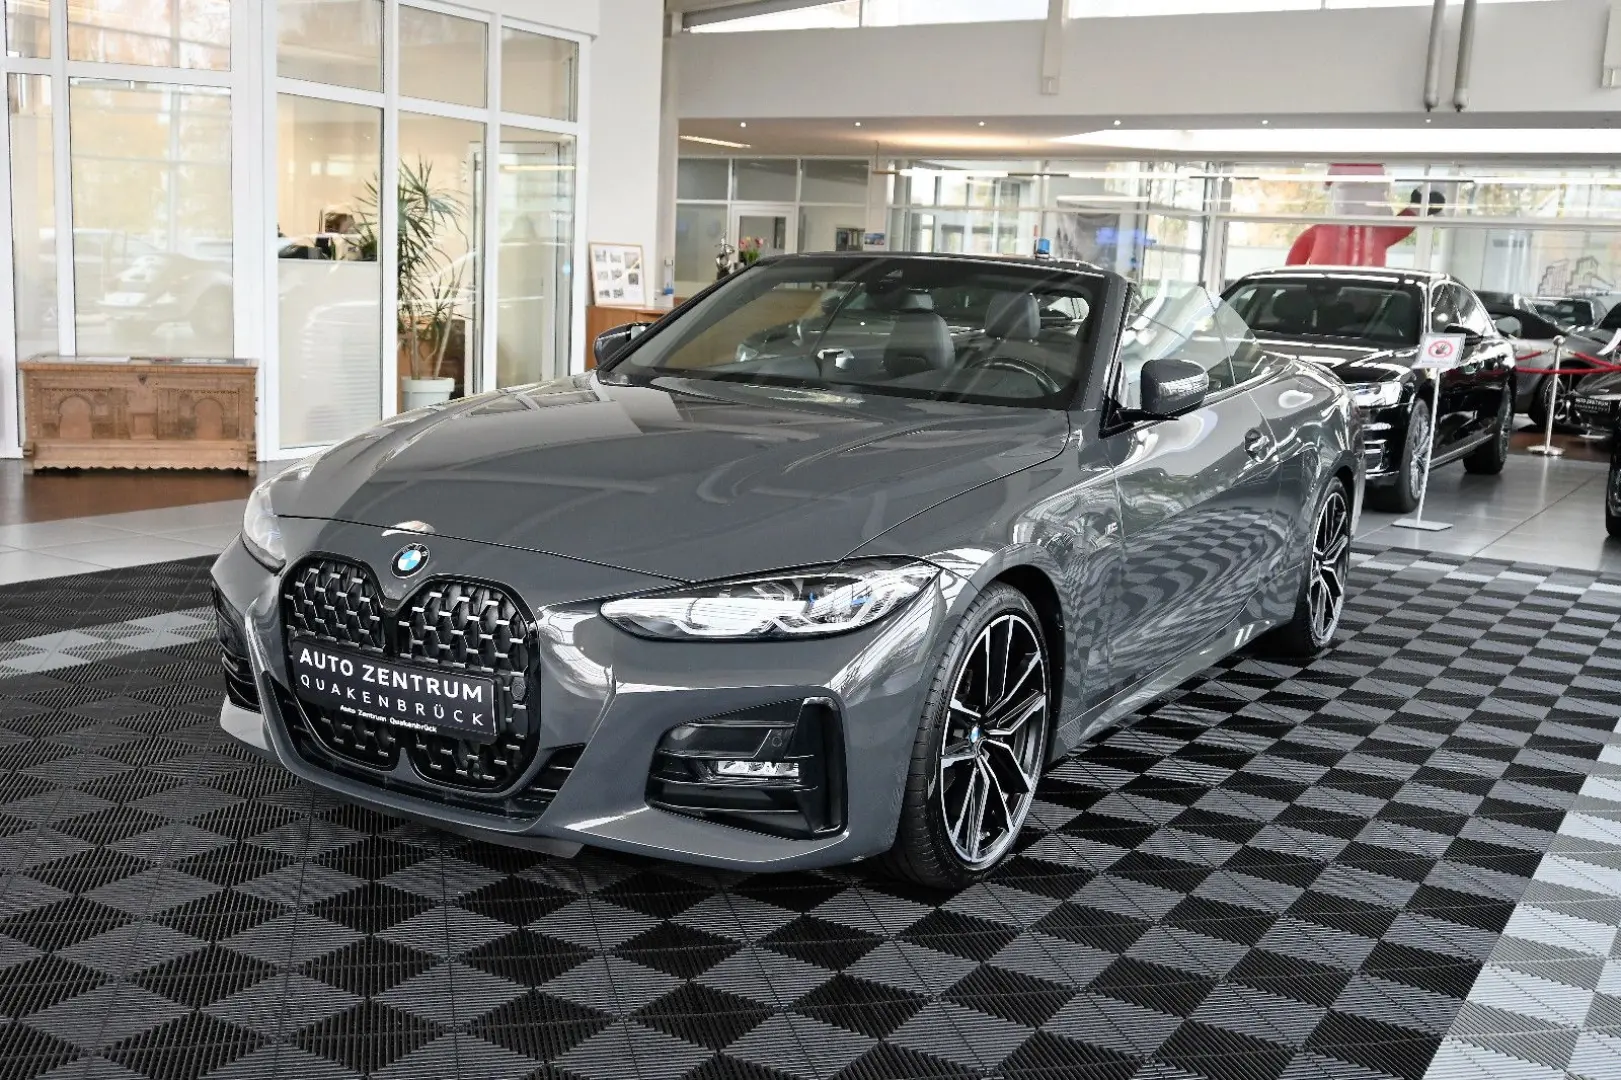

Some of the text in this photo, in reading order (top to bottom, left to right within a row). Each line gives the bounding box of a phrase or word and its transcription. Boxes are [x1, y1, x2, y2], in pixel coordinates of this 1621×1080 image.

[299, 648, 482, 703] AUTO ZENTRUM
[300, 674, 484, 726] QUAKENBRÜCK
[340, 704, 437, 733] Auto Zentrum Quakenbrück
